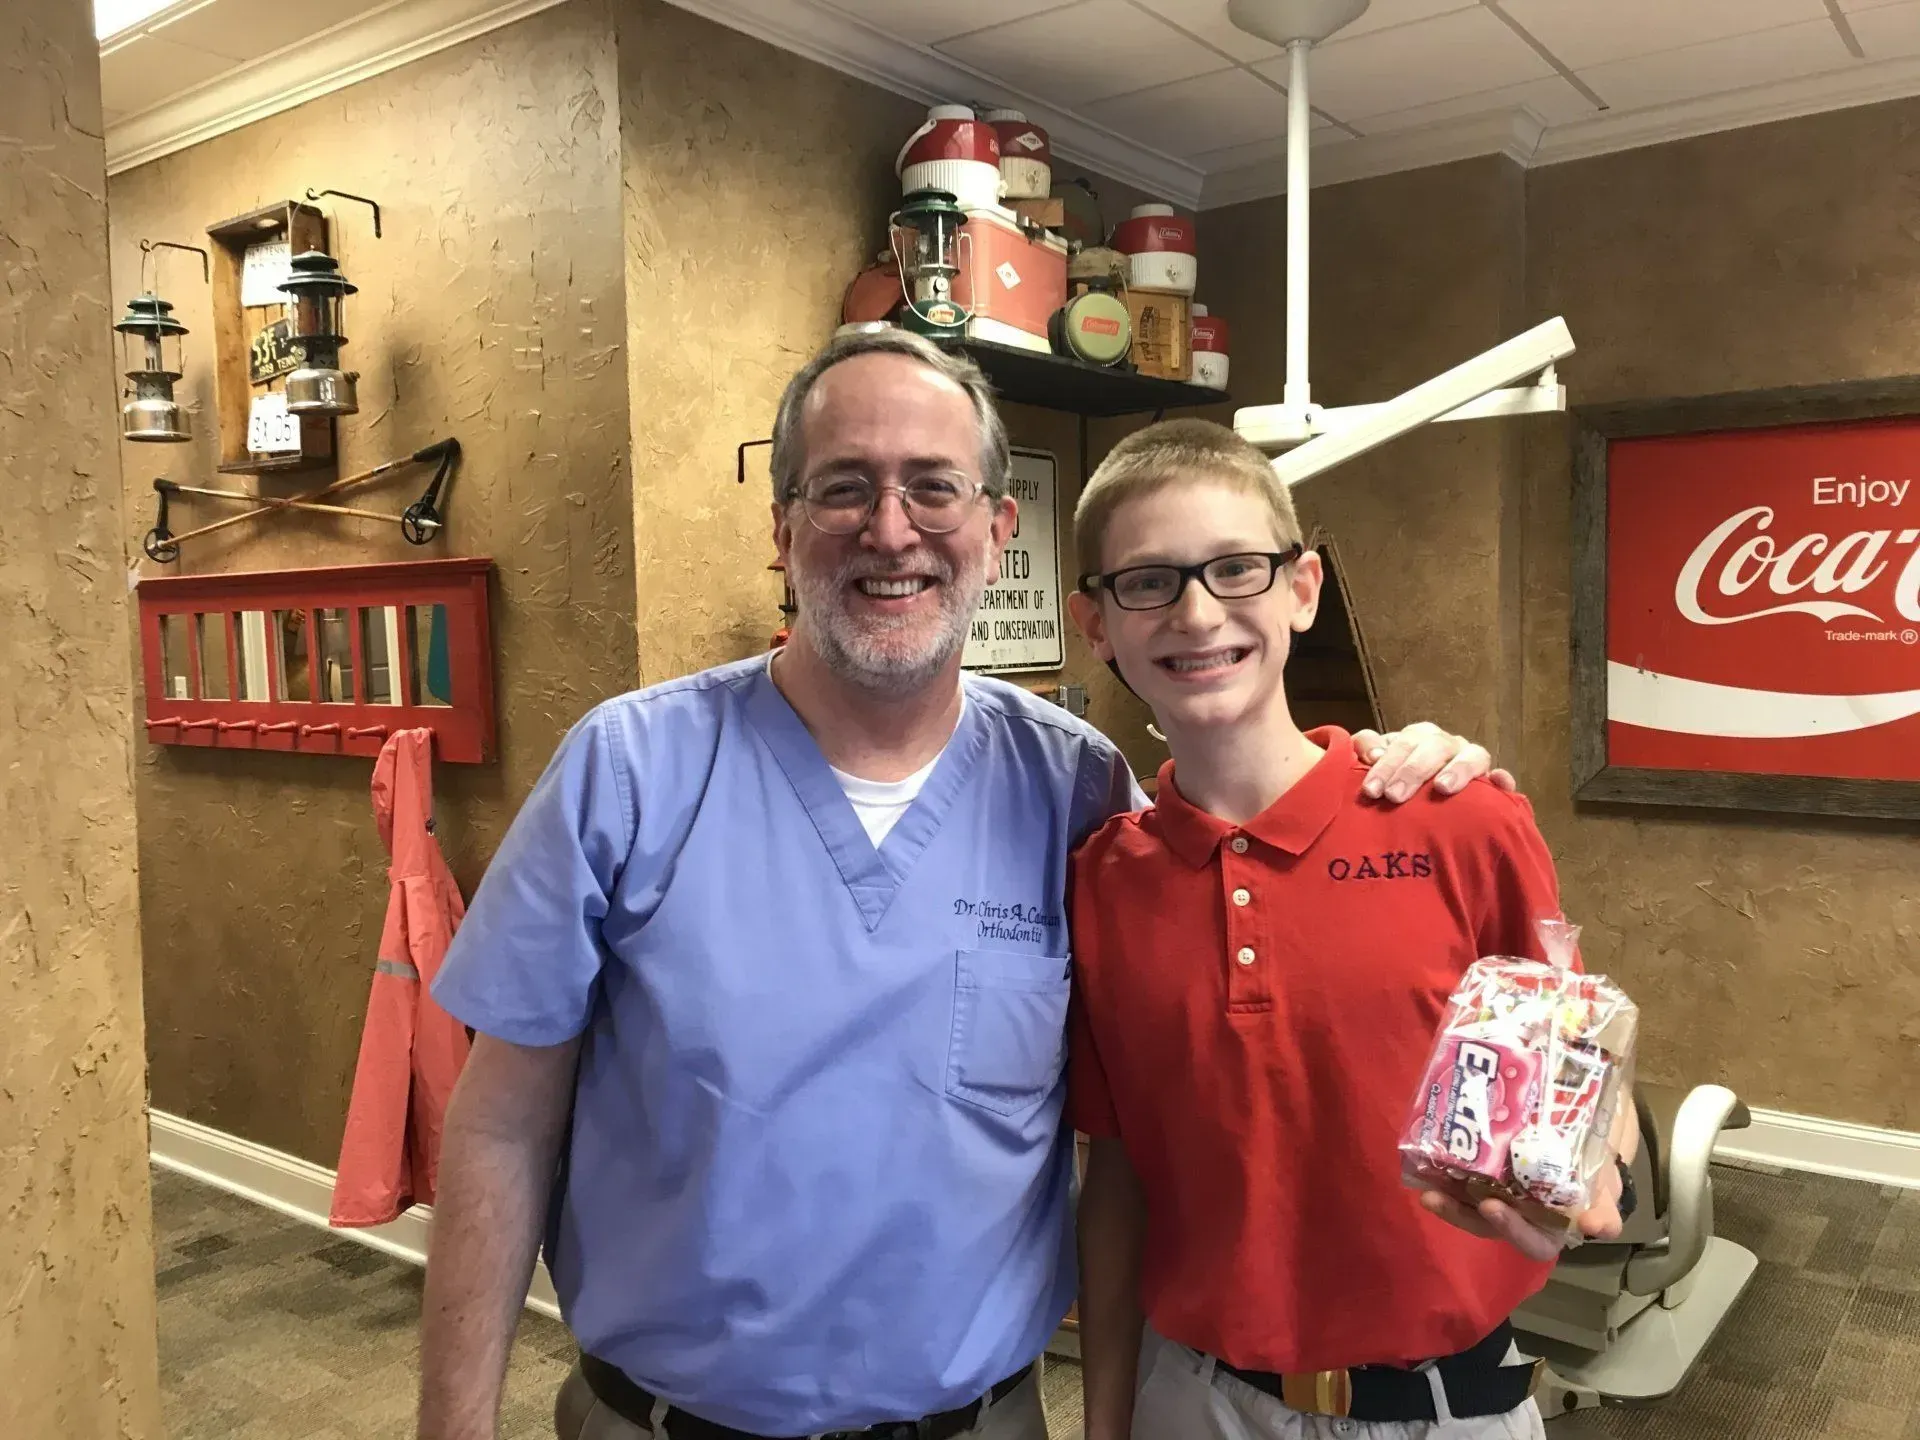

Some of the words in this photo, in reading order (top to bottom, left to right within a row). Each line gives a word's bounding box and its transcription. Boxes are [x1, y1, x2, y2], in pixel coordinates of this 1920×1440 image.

[1009, 478, 1039, 501] UPPLY
[1813, 475, 1910, 507] Enjoy
[1675, 506, 1920, 625] Coca-
[1033, 590, 1045, 610] OF
[971, 621, 989, 641] AND
[994, 619, 1055, 641] CONSERVATION
[1825, 630, 1897, 641] Trade-mark
[1328, 851, 1432, 881] OAKS
[1425, 1083, 1441, 1119] CLASSIC
